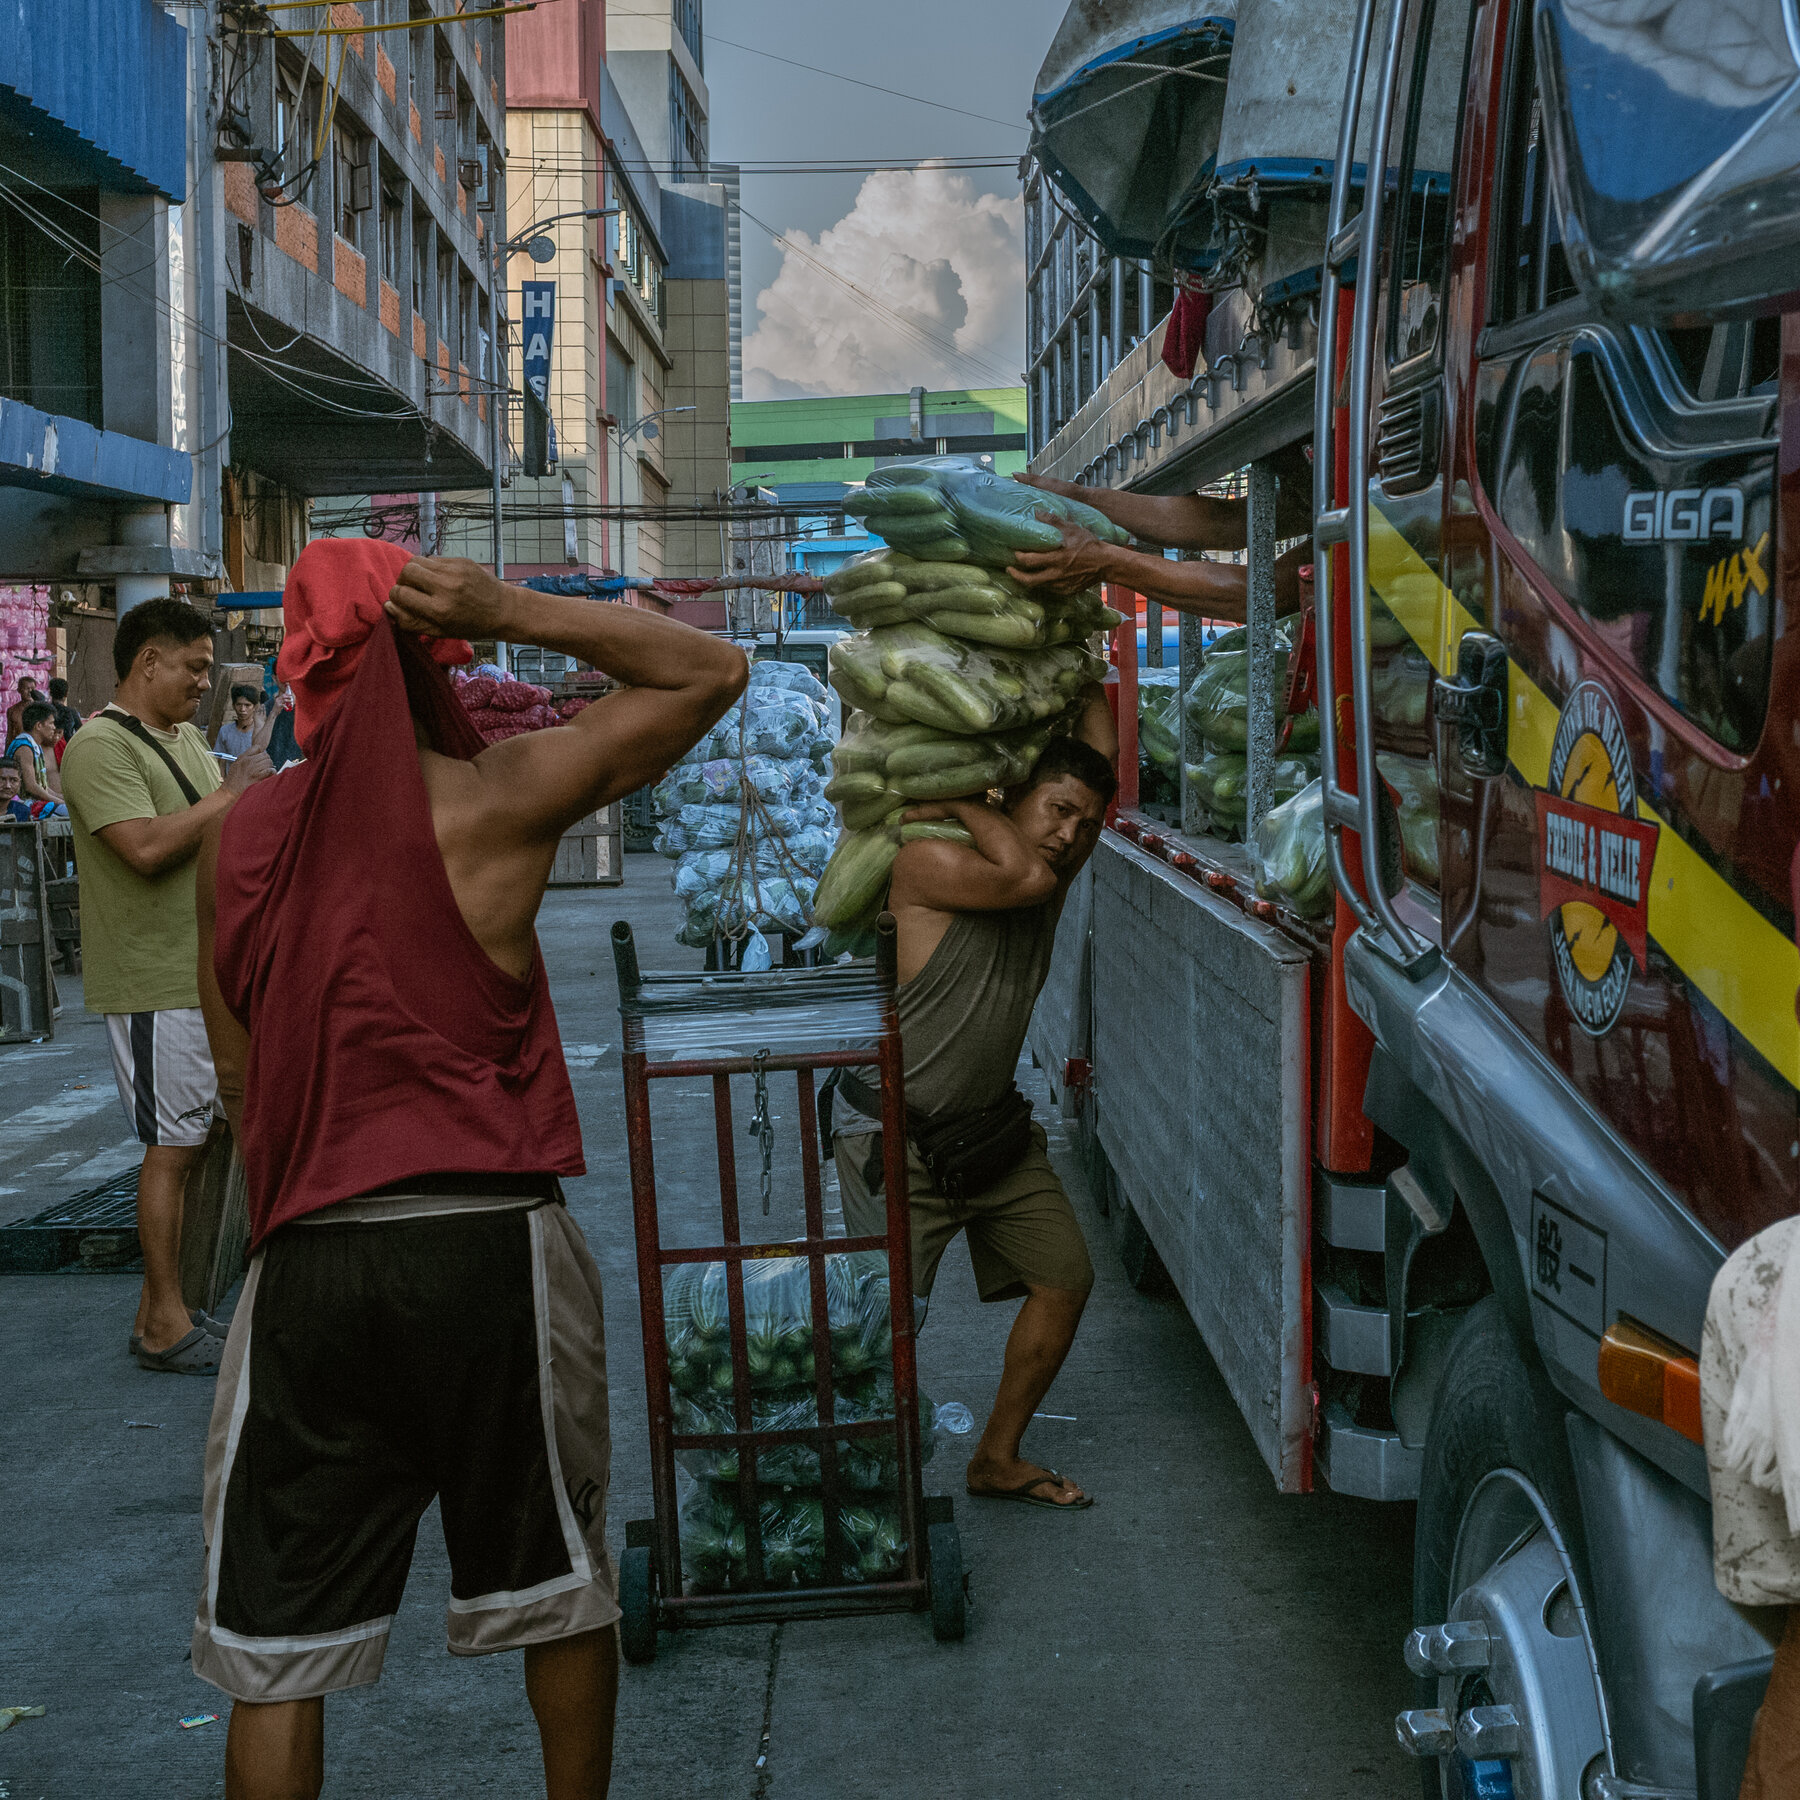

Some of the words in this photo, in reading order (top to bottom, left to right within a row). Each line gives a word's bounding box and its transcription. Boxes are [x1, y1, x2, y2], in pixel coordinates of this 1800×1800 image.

[1623, 488, 1744, 540] GIGA
[1699, 532, 1769, 626] MAX
[1546, 811, 1585, 880] FREDIE
[1588, 826, 1597, 886] &
[1600, 829, 1640, 902] NELIE
